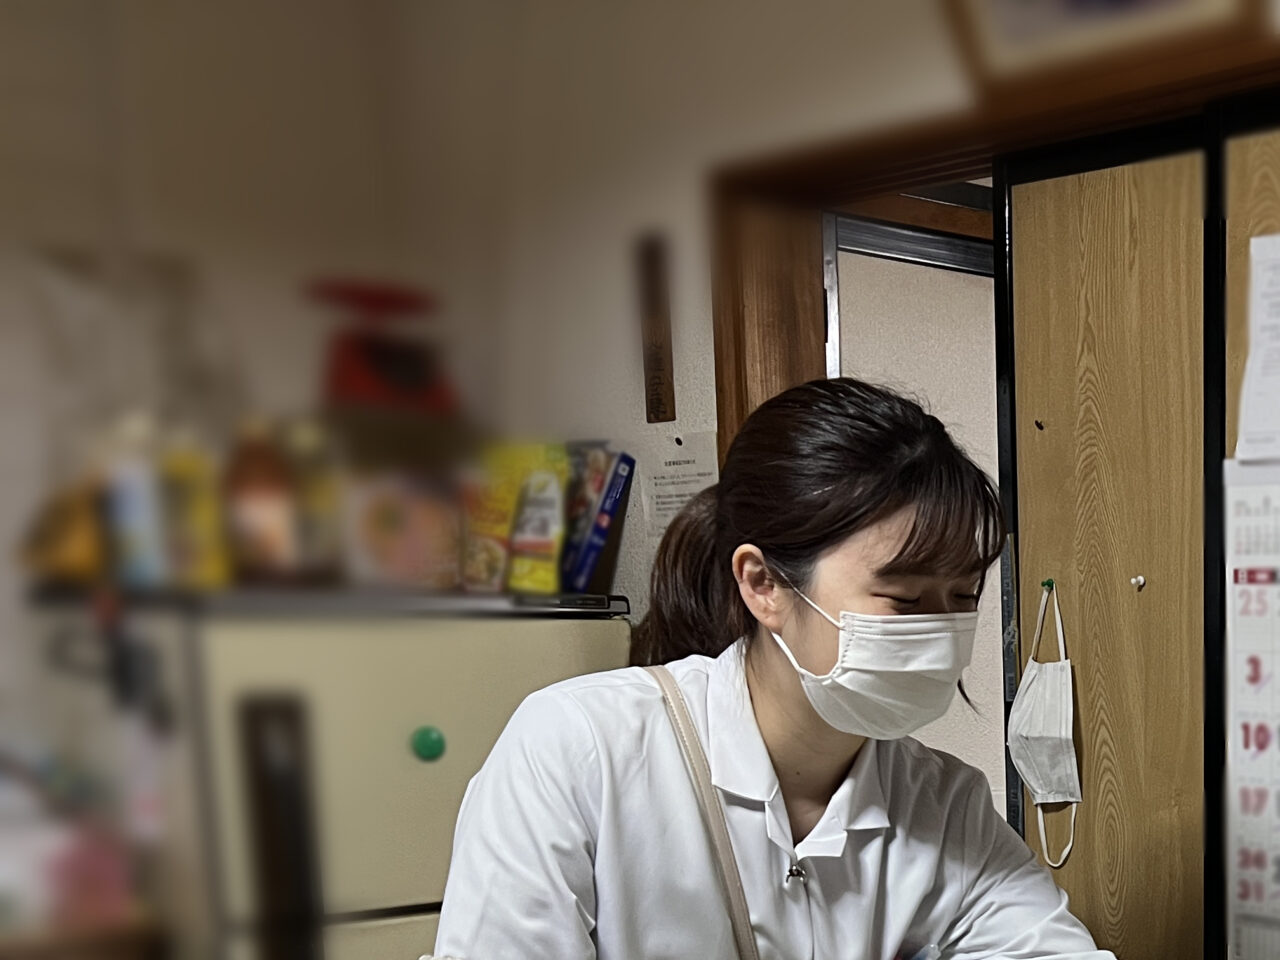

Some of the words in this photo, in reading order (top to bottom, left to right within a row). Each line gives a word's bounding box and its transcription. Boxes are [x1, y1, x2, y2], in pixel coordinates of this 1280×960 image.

[1238, 590, 1268, 617] 25
[1246, 655, 1262, 685] 3
[1241, 722, 1271, 751] 10
[1239, 786, 1269, 816] 17
